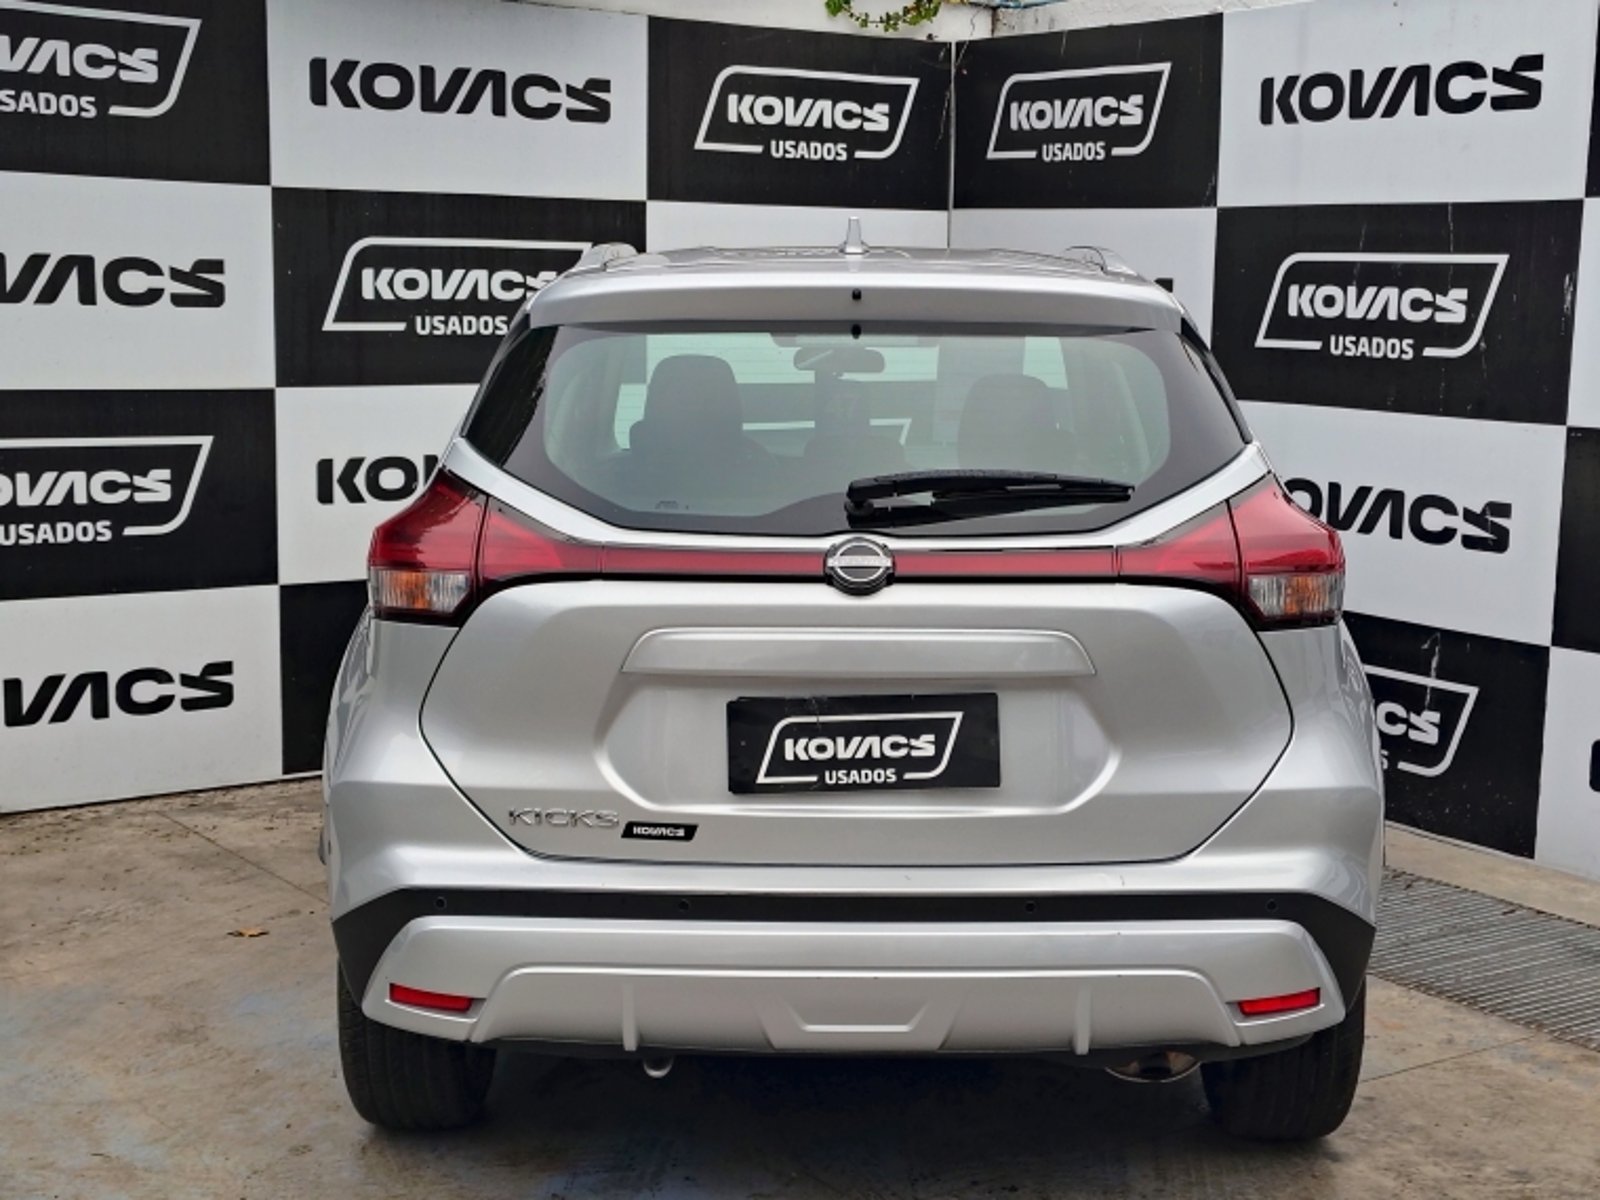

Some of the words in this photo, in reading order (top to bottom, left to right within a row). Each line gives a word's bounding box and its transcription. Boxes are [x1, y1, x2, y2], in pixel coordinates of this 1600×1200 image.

[309, 57, 610, 123] KOVACS
[1260, 54, 1544, 125] KOVACS
[728, 94, 889, 131] KOVACS
[1011, 95, 1143, 130] KOVACS
[771, 140, 847, 160] USADOS
[1043, 141, 1105, 161] USADOS
[1288, 285, 1467, 323] KOVACS
[415, 315, 508, 335] USADOS
[1330, 335, 1413, 360] USADOS
[0, 521, 112, 545] USADOS
[4, 661, 233, 727] VACS
[785, 735, 935, 760] KOVACS
[825, 768, 896, 784] USADOS
[508, 807, 620, 828] KICKS
[632, 826, 685, 837] KOVACS
